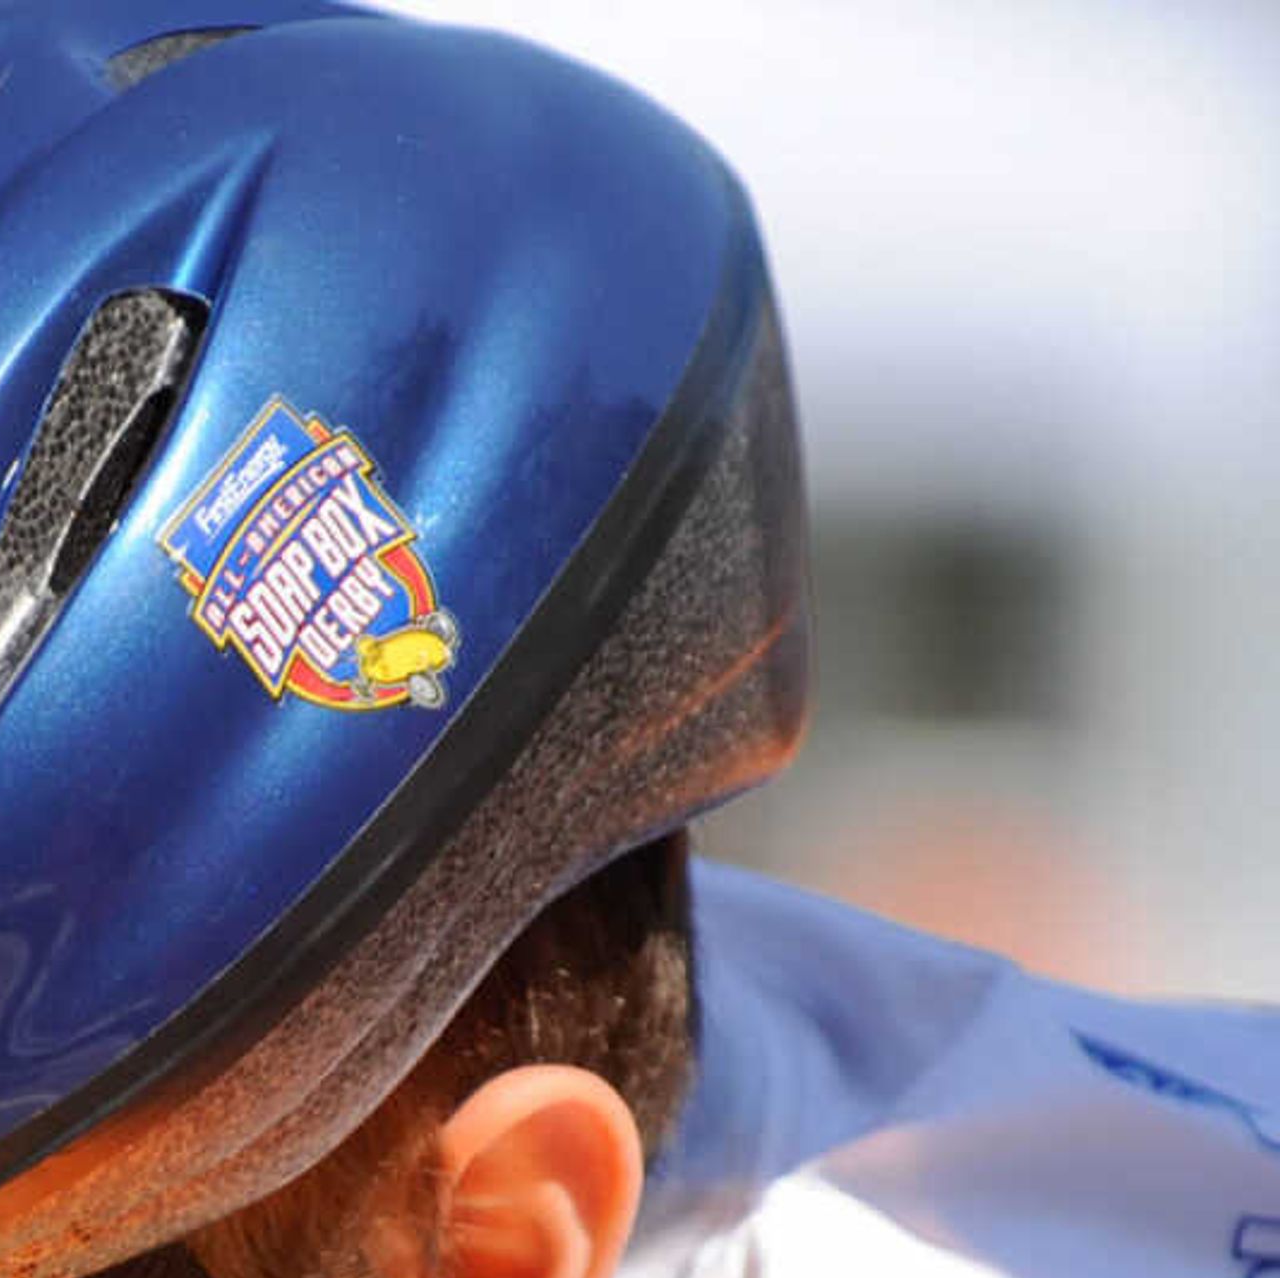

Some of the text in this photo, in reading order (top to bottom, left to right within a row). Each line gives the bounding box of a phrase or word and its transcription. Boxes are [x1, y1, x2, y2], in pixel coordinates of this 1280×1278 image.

[229, 475, 397, 675] SOAP BOX
[299, 554, 394, 668] DERBY
